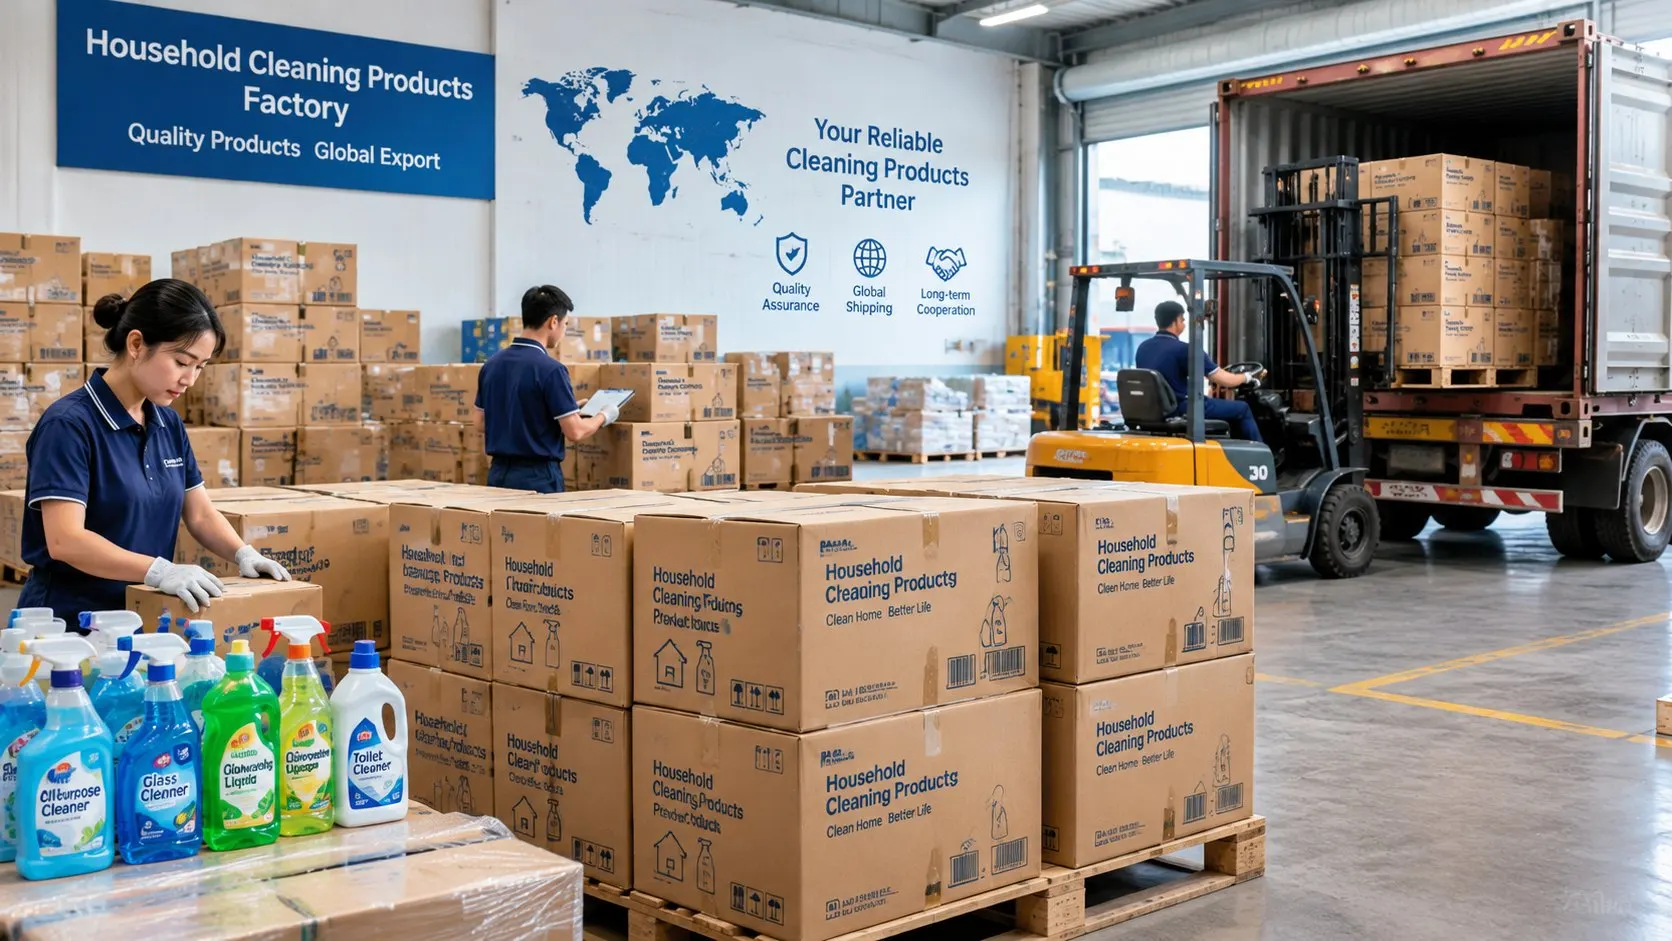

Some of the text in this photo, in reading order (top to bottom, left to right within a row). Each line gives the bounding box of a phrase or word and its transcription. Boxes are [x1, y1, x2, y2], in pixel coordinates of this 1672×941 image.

[86, 28, 473, 101] Household Cleaning Products
[243, 86, 349, 127] Factory
[128, 123, 441, 171] Quality Products Global Export
[814, 118, 943, 154] Your Reliable
[786, 148, 969, 186] Cleaning Products
[841, 184, 915, 211] Partner
[772, 282, 811, 297] Quality
[853, 285, 886, 298] Global
[921, 288, 970, 301] Long-term
[762, 298, 820, 312] Assurance
[846, 301, 893, 316] Shipping
[917, 303, 975, 317] Cooperation
[1249, 465, 1268, 480] 30
[1098, 534, 1156, 555] Household
[505, 556, 553, 578] Household
[825, 555, 903, 581] Household
[1097, 550, 1195, 575] Cleaning Products
[653, 566, 715, 589] Household
[653, 586, 701, 612] Cleaning
[826, 601, 931, 627] Clean Home Better Life
[1096, 711, 1155, 738] Household
[507, 733, 558, 760] Household
[1096, 721, 1194, 757] Cleaning Products
[353, 750, 383, 763] Toilet
[143, 774, 177, 788] Glass
[653, 759, 713, 790] Household
[826, 759, 905, 793] Household
[698, 792, 744, 820] Products
[825, 770, 959, 816] Cleaning Products
[42, 801, 90, 817] Cleaner
[827, 802, 932, 839] Clean Home Better Life
